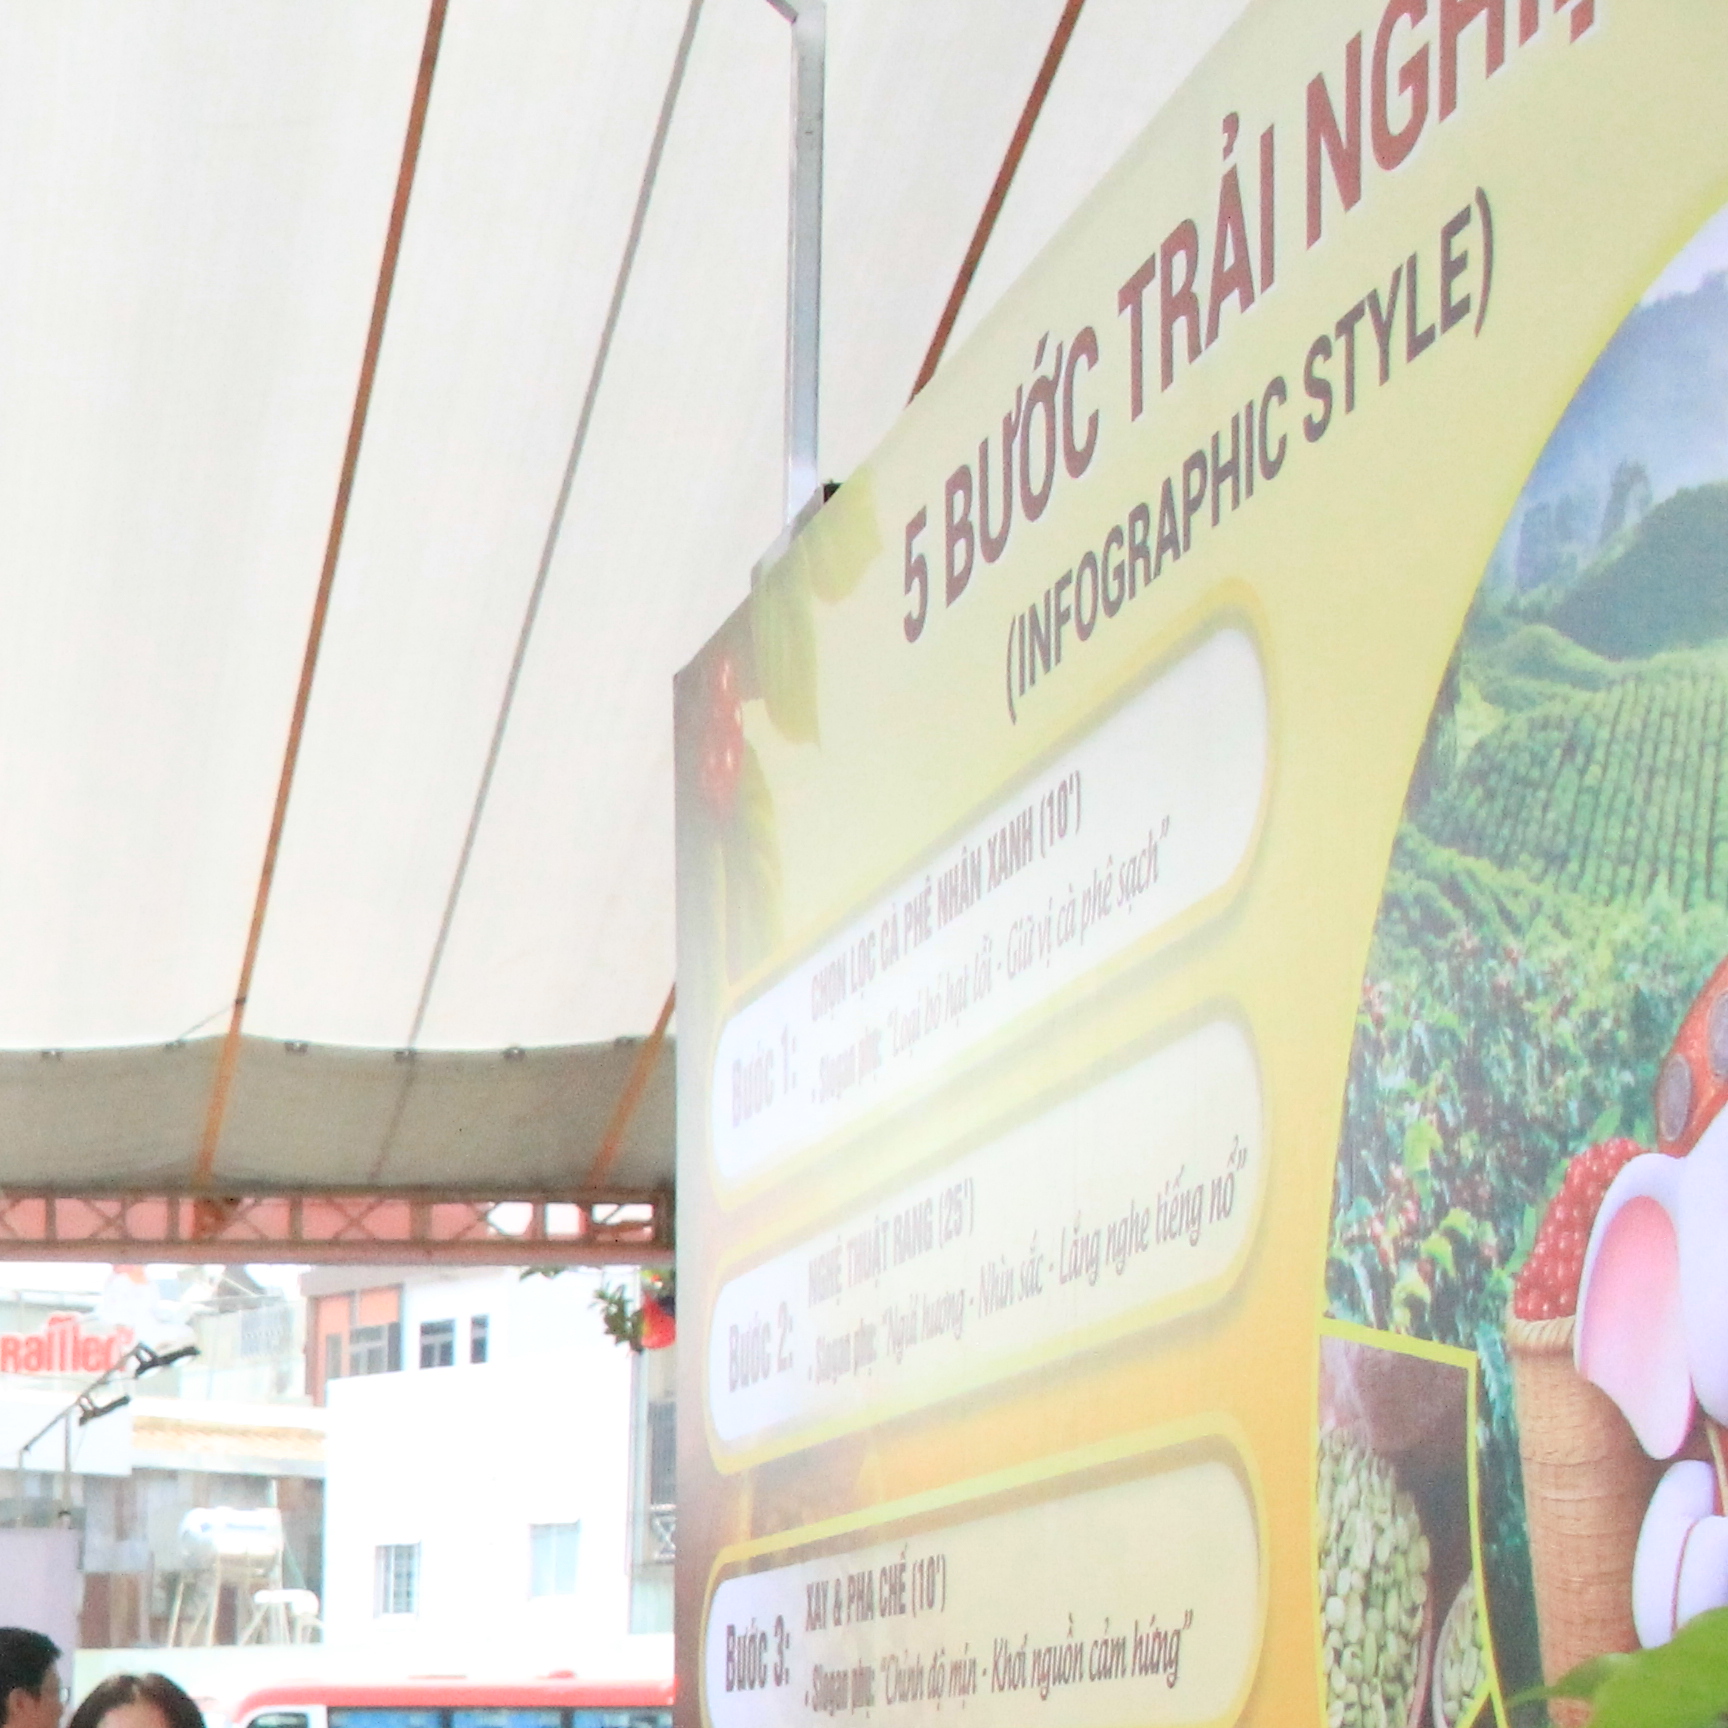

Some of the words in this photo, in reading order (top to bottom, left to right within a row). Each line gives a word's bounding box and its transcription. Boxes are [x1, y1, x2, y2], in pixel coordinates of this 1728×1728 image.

[903, 505, 929, 643] 5
[945, 326, 1099, 609] BƯỚC
[1117, 111, 1274, 423] TRẢI
[1006, 375, 1287, 724] (INFOGRAPHIC
[1302, 187, 1493, 445] STYLE)
[938, 846, 981, 930] NHÂN
[988, 805, 1032, 892] XANH
[1040, 770, 1081, 857] (10')
[1057, 882, 1075, 948] cà
[1081, 853, 1113, 946] phê
[893, 1200, 934, 1268] RANG
[939, 1176, 975, 1245] (25')
[1058, 1211, 1099, 1288] Lắng
[1105, 1198, 1149, 1276] nghe
[1155, 1164, 1203, 1248] tiếng
[729, 1313, 771, 1393] Bước
[777, 1301, 794, 1373] 2:
[805, 1580, 828, 1632] XAY
[834, 1581, 842, 1626] &
[847, 1570, 874, 1625] PHA
[879, 1543, 908, 1618] CHẾ
[911, 1553, 946, 1617] (10')
[725, 1616, 768, 1693] Bước
[774, 1614, 790, 1684] 3:
[927, 1652, 944, 1711] độ
[948, 1642, 978, 1709] mịn
[1031, 1612, 1084, 1701] nguồn
[1088, 1616, 1127, 1682] cảm
